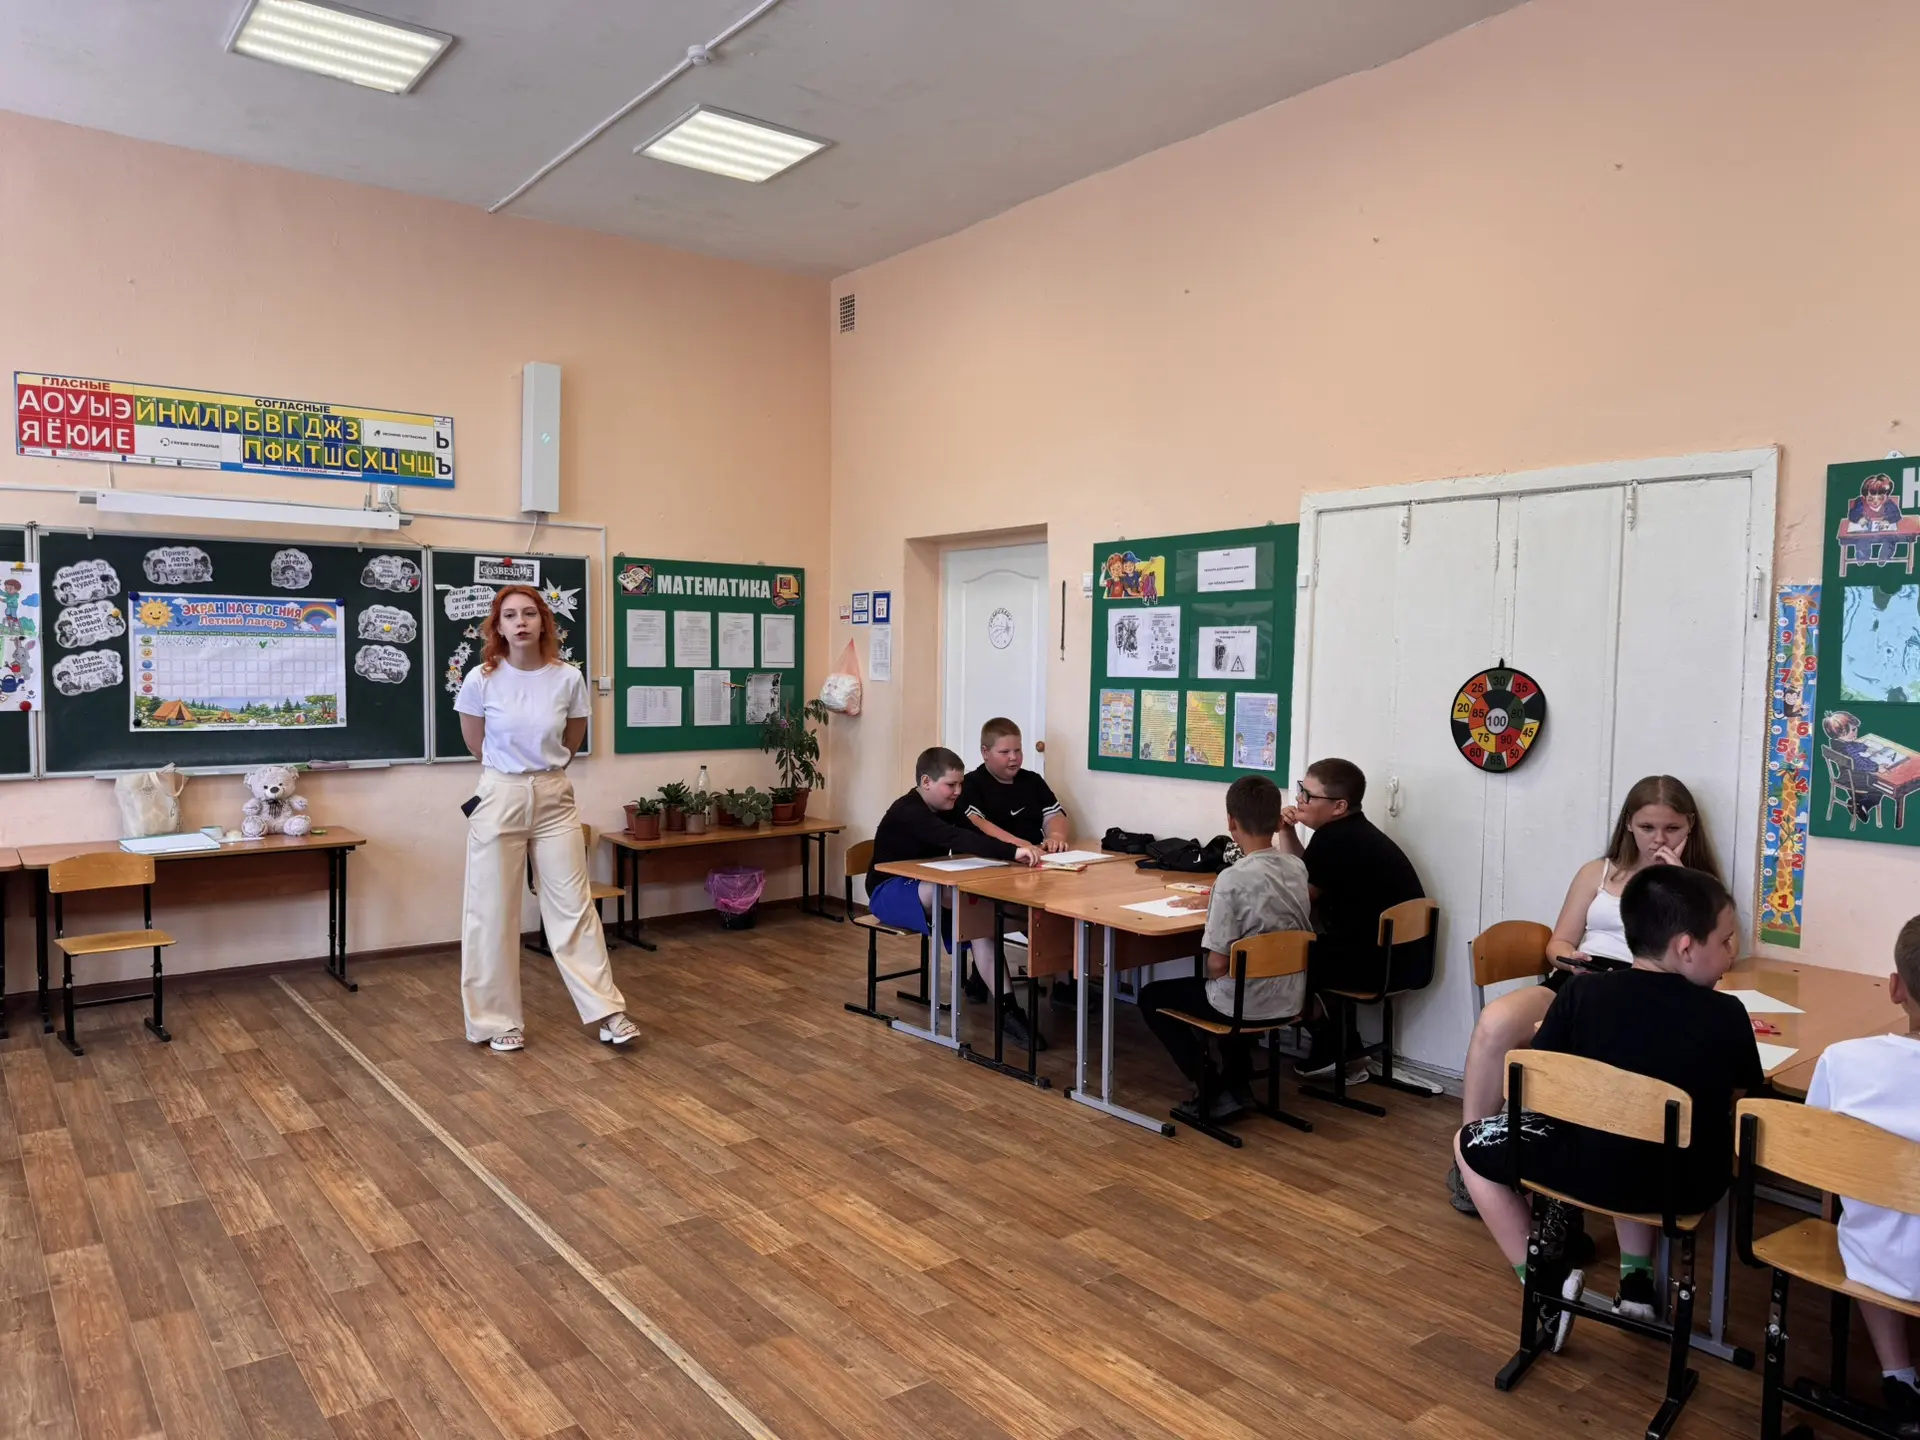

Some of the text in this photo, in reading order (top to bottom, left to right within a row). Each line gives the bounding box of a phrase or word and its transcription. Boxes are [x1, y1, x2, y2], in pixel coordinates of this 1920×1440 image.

[42, 376, 111, 391] ГЛАСНЫЕ
[254, 398, 331, 414] СОГЛАСНЫЕ
[71, 572, 95, 583] время
[73, 577, 99, 590] чудес!
[656, 574, 771, 599] МАТЕМАТИКА
[67, 605, 99, 617] Каждый
[182, 602, 302, 622] ЭКРАН НАСТРОЕНИЯ
[460, 609, 475, 617] ВСЕЙ
[76, 616, 102, 628] новый
[199, 615, 287, 631] Летний лагерь
[1800, 613, 1819, 626] 10
[80, 622, 104, 635] квест!
[1781, 630, 1792, 643] 9
[1803, 655, 1816, 672] 8
[1493, 675, 1506, 686] 30
[1778, 668, 1791, 683] 7
[1471, 683, 1484, 693] 25
[1515, 682, 1528, 693] 35
[1457, 702, 1470, 713] 20
[1471, 708, 1485, 718] 85
[1486, 715, 1507, 727] 100
[1521, 727, 1534, 738] 45
[1796, 721, 1809, 736] 6
[1477, 732, 1490, 743] 75
[1500, 734, 1512, 744] 90
[1776, 738, 1790, 753] 5
[1469, 747, 1482, 758] 60
[1509, 748, 1520, 758] 50
[1795, 777, 1808, 793] 4
[1771, 809, 1783, 824] 3
[1791, 853, 1804, 869] 2
[1777, 894, 1788, 909] 1
